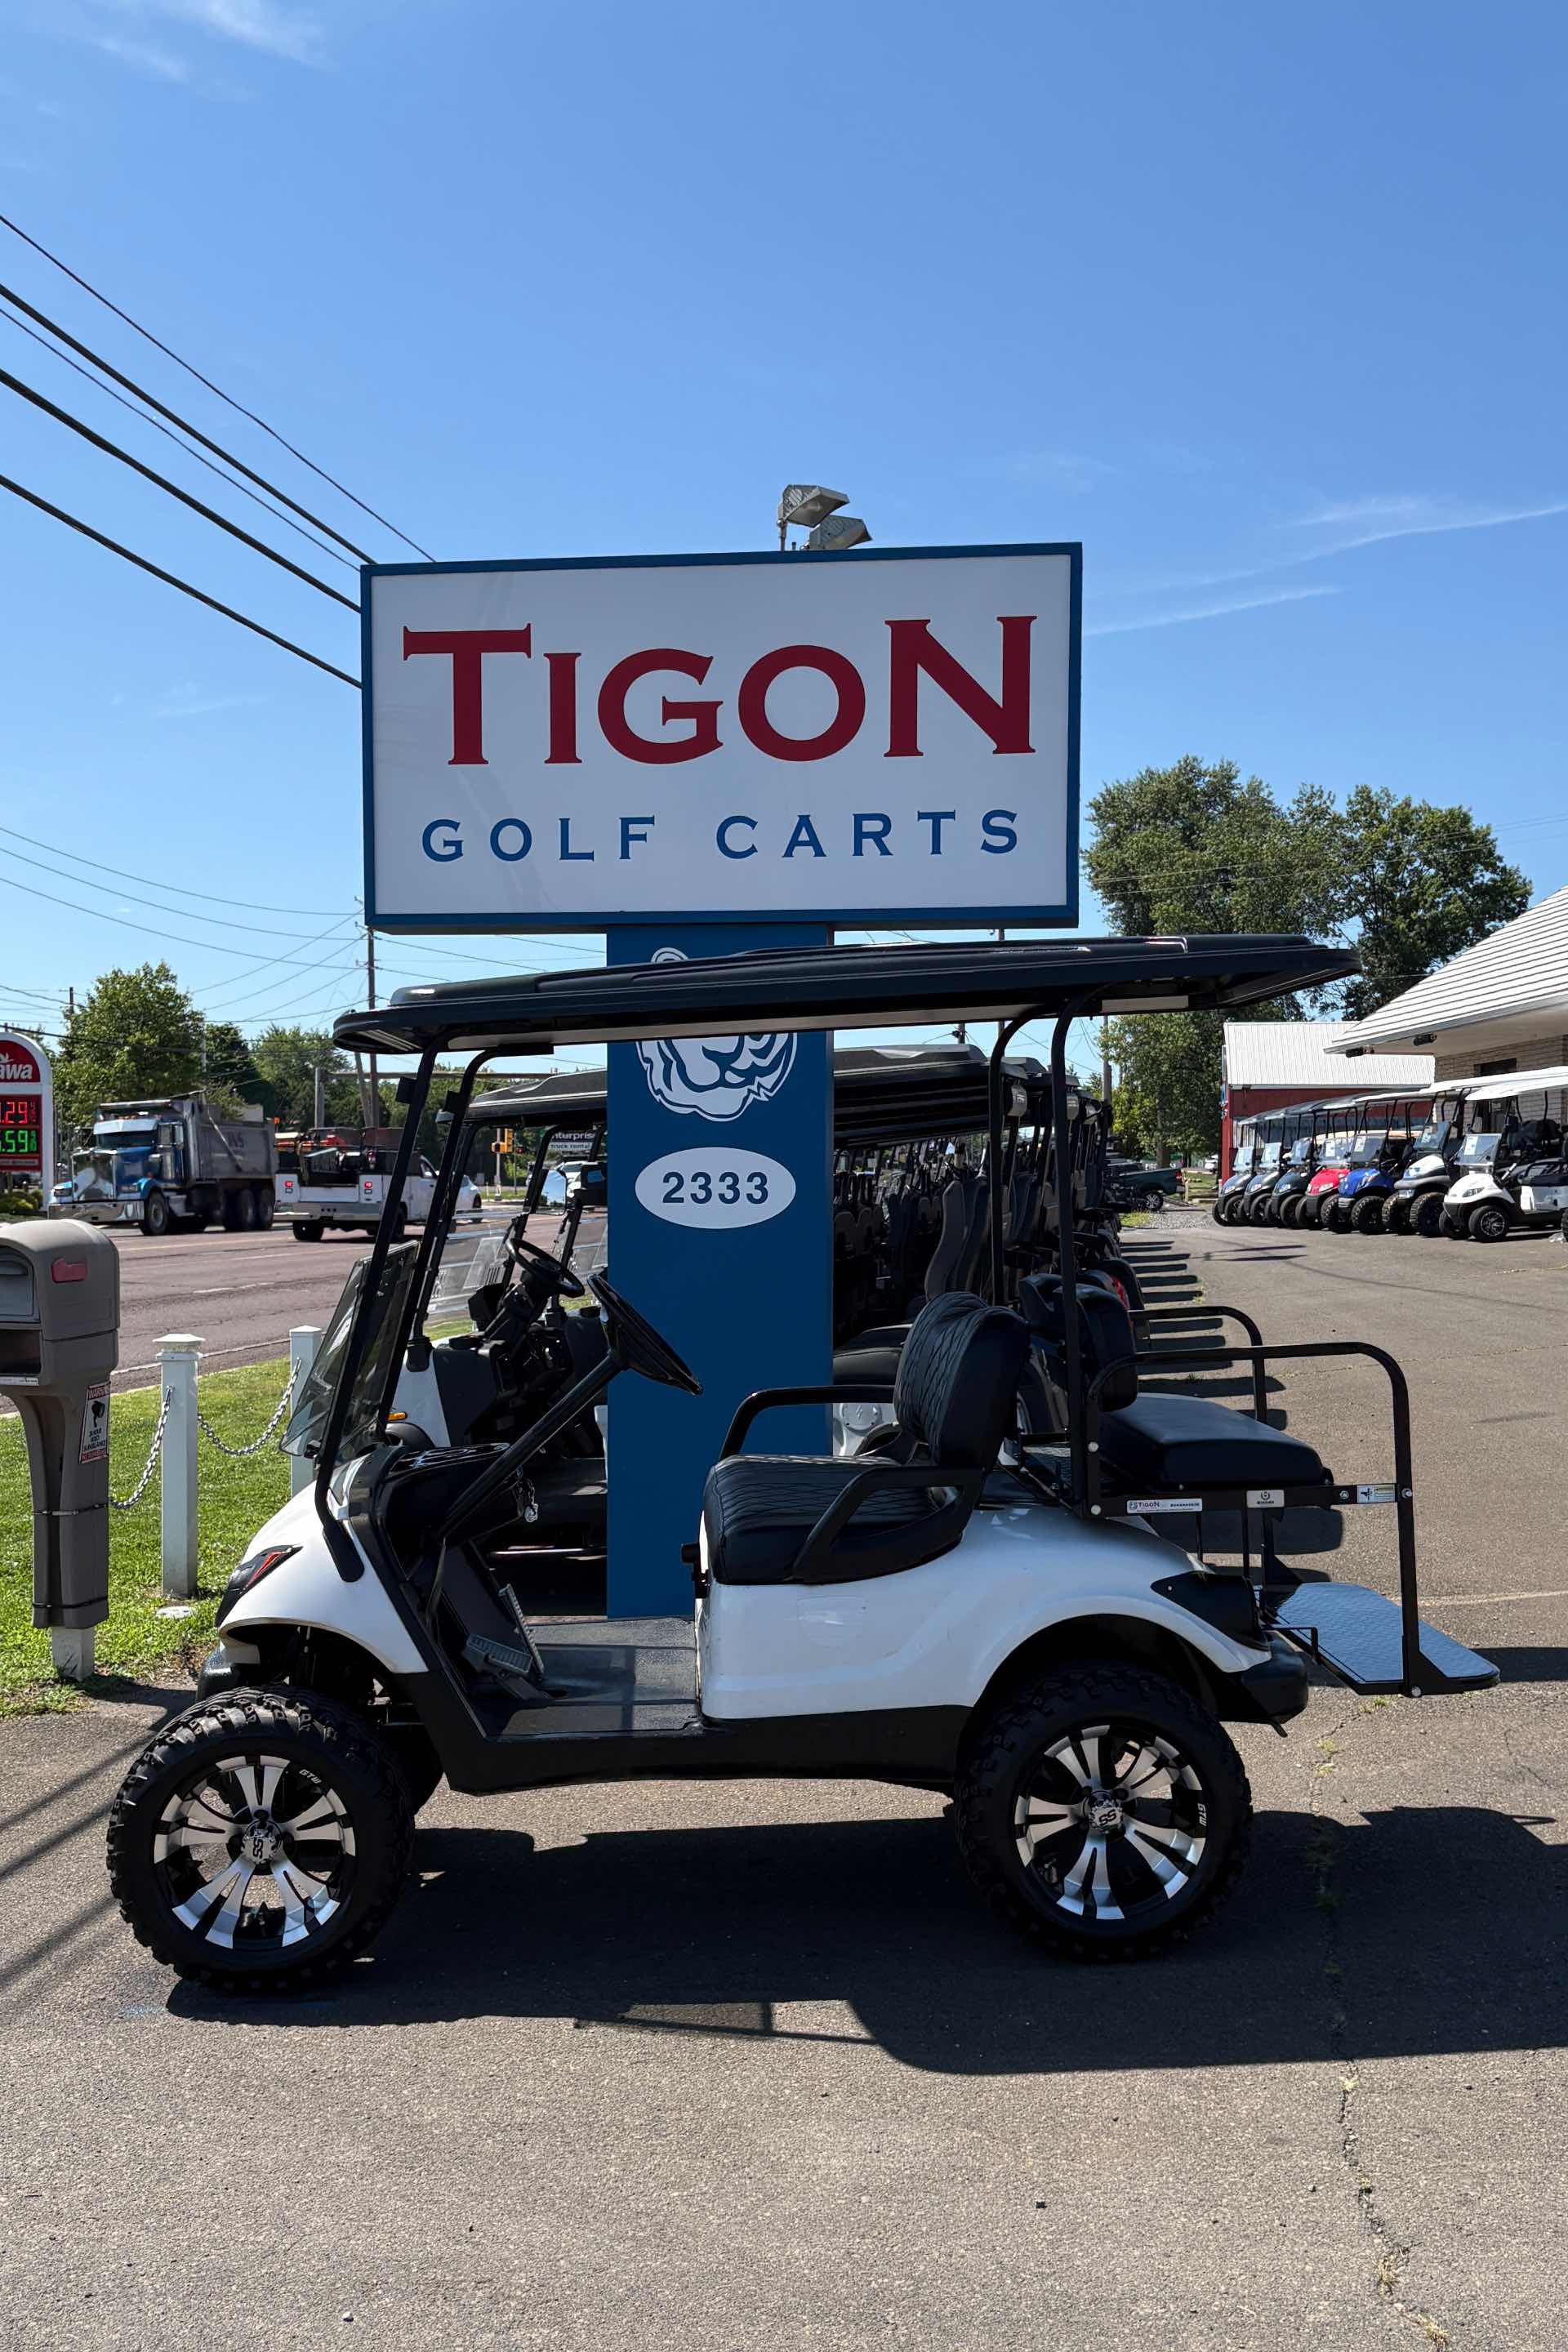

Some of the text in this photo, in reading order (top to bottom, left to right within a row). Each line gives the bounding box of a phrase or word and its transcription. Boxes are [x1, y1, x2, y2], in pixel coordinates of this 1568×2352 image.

[403, 615, 1037, 764] TIGON
[421, 809, 1018, 862] GOLF CARTS
[662, 1172, 768, 1205] 2333
[299, 1769, 322, 1784] GTW
[1197, 1802, 1207, 1826] GTW
